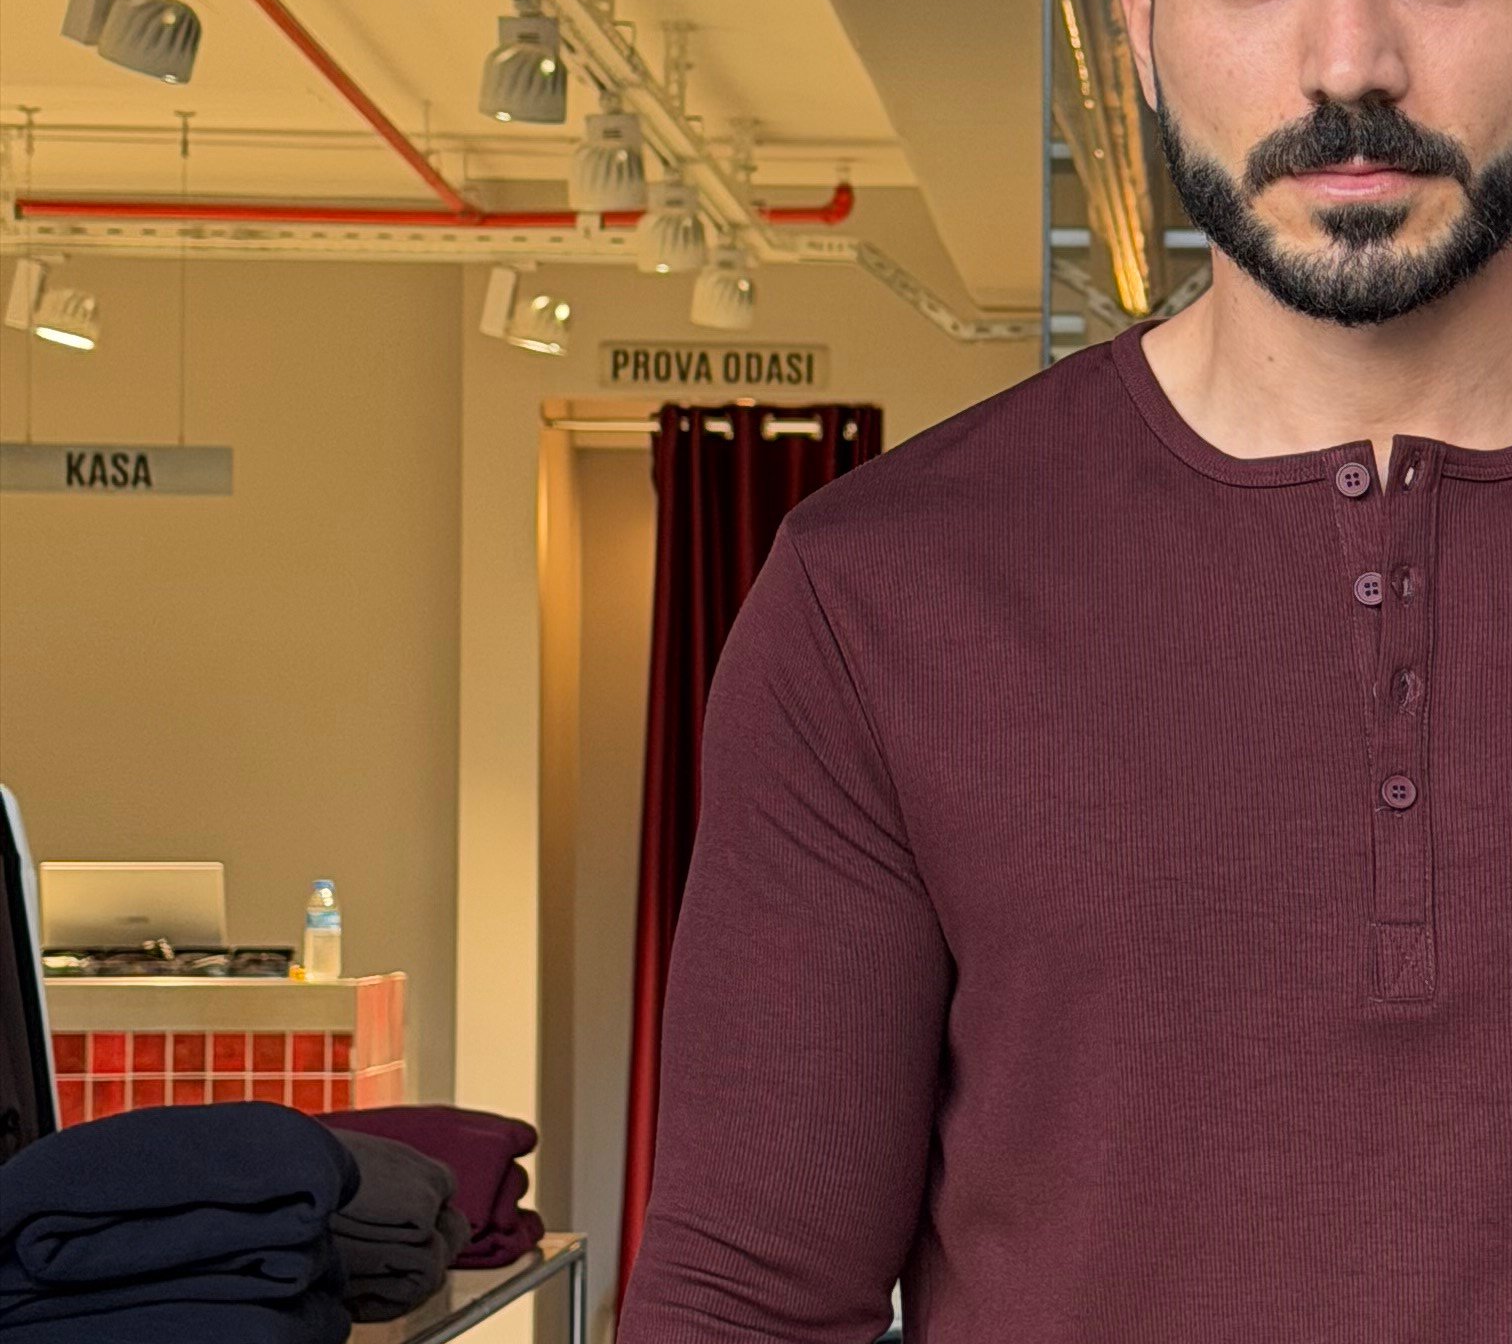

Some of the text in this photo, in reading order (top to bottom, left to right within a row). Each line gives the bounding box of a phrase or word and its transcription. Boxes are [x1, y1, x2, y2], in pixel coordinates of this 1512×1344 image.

[612, 349, 814, 384] PROVA ODASI
[66, 452, 152, 487] KASA
